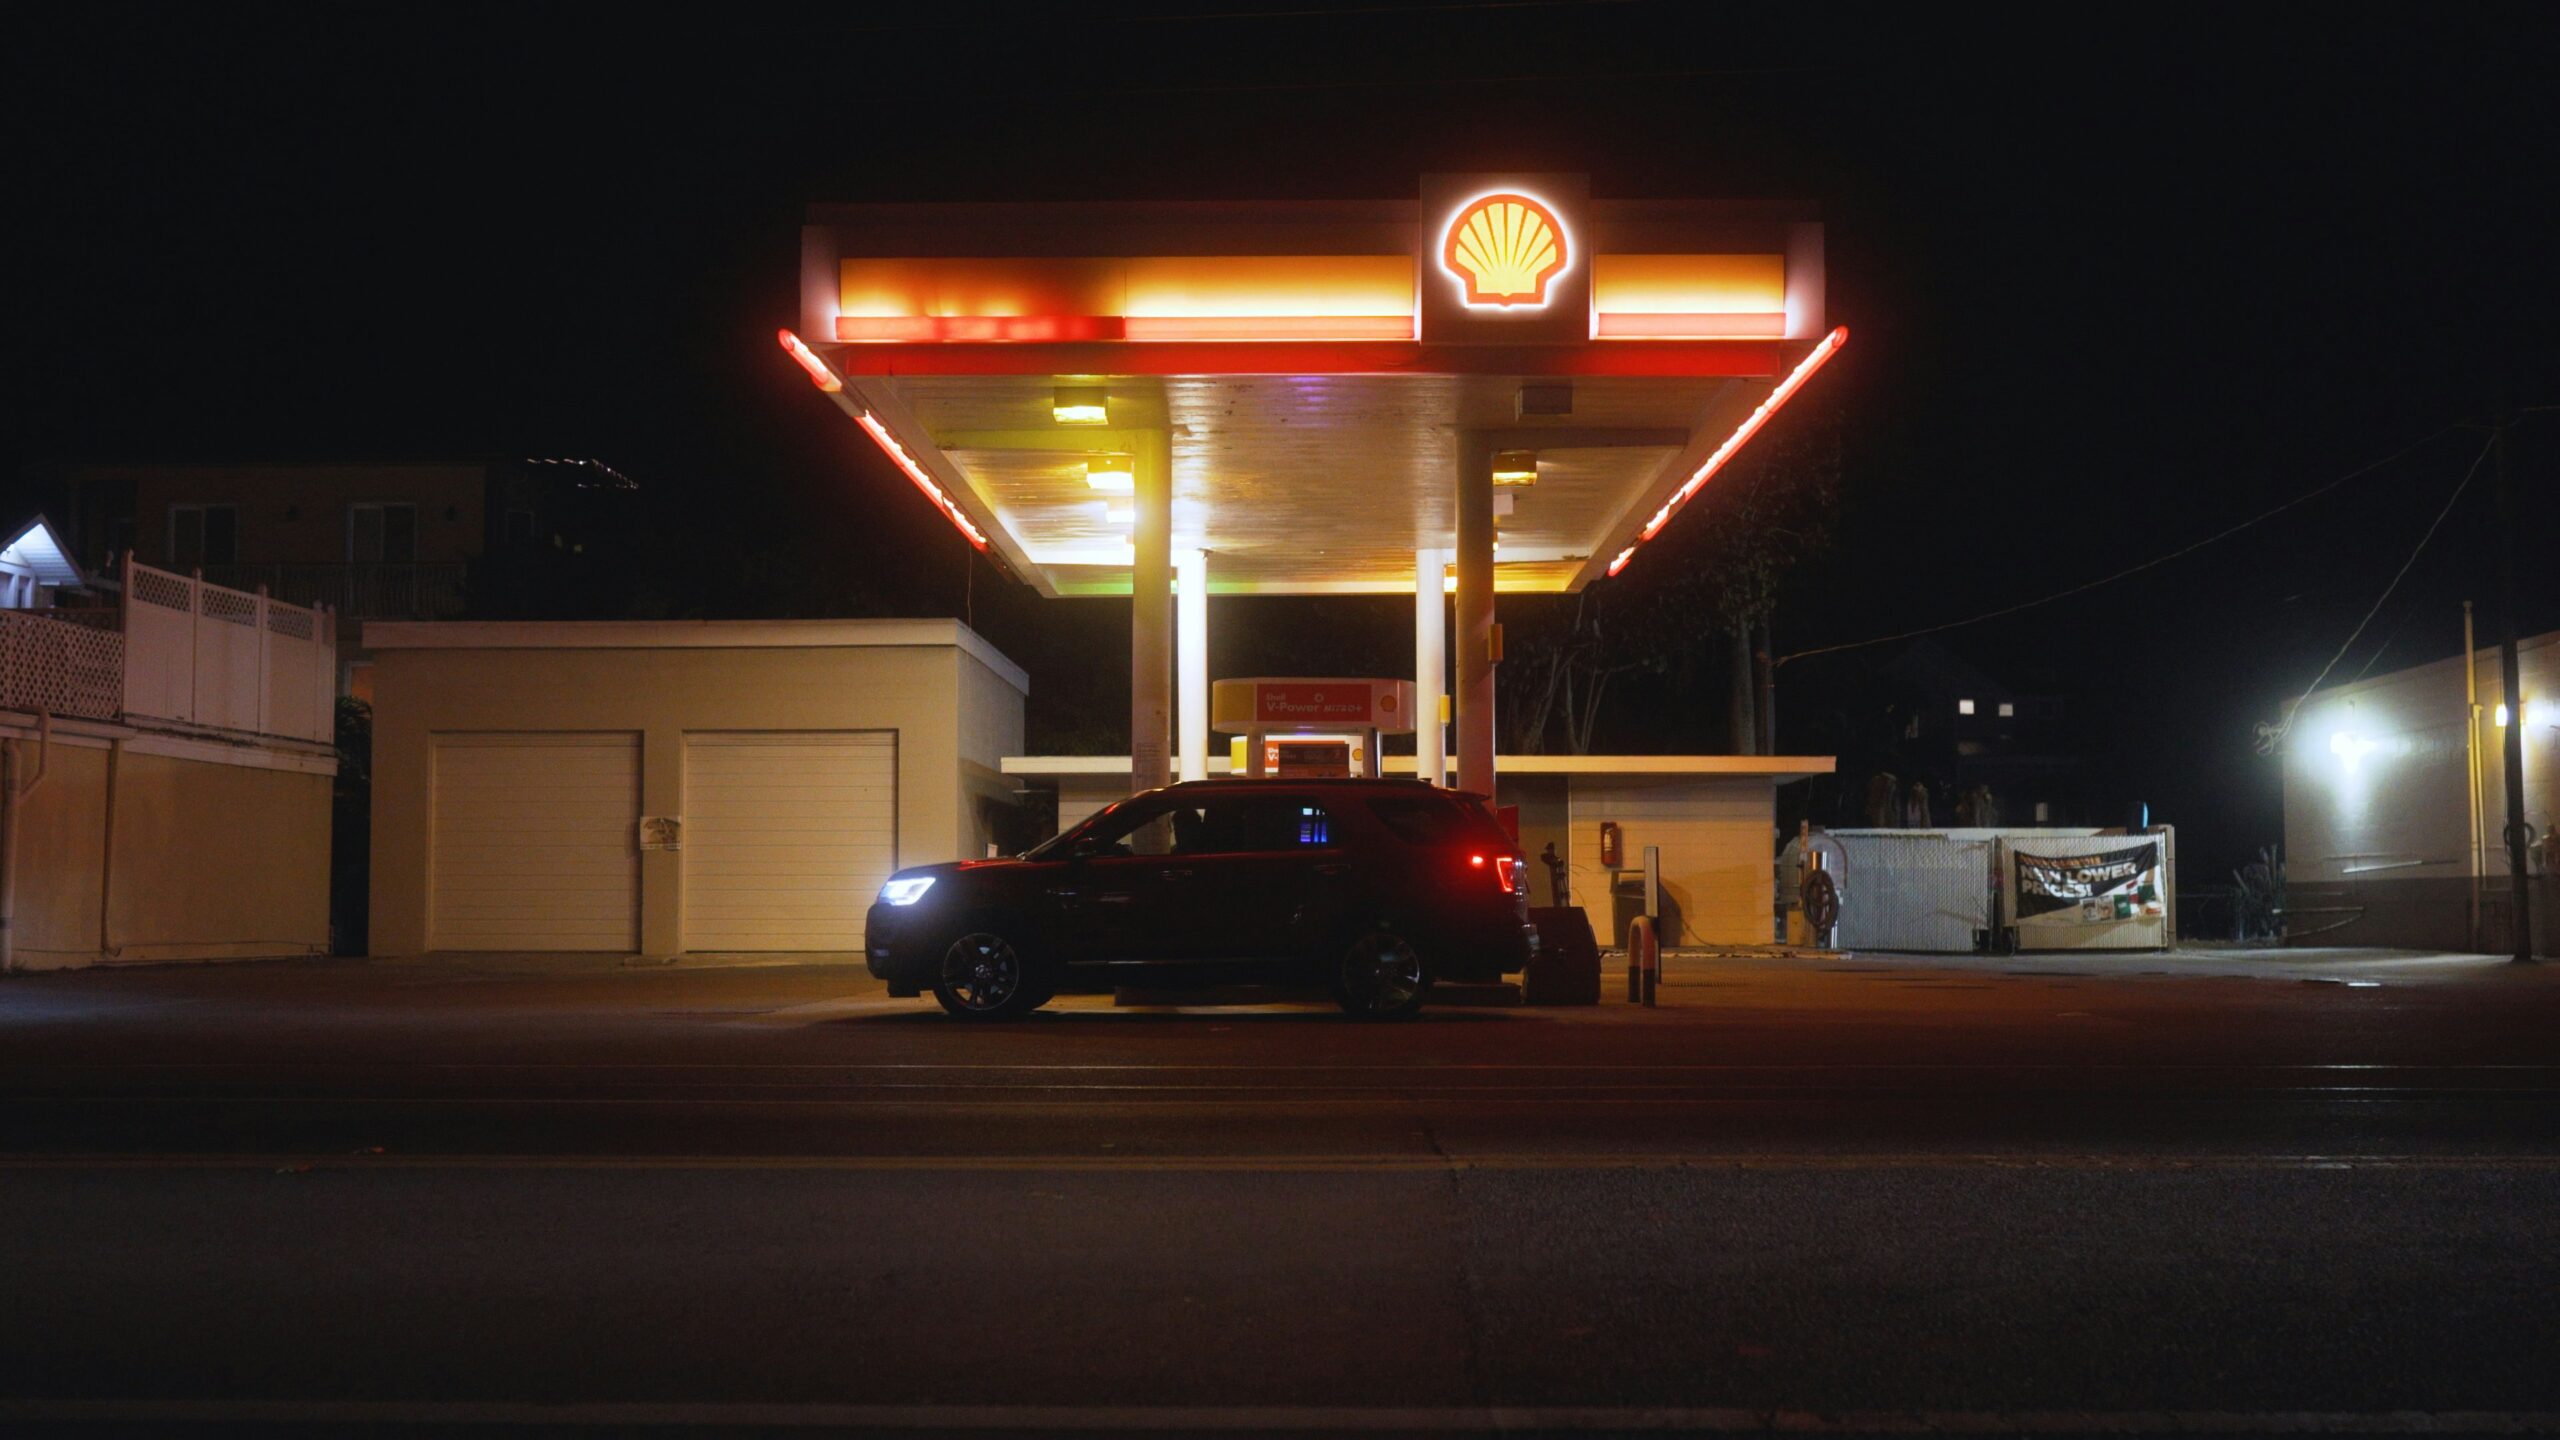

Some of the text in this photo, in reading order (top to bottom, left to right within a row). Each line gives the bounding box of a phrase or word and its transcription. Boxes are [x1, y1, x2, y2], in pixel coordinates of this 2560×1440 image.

[1266, 702, 1320, 713] V-Power
[2066, 861, 2137, 884] LOWER
[2021, 879, 2093, 898] PRICES!
